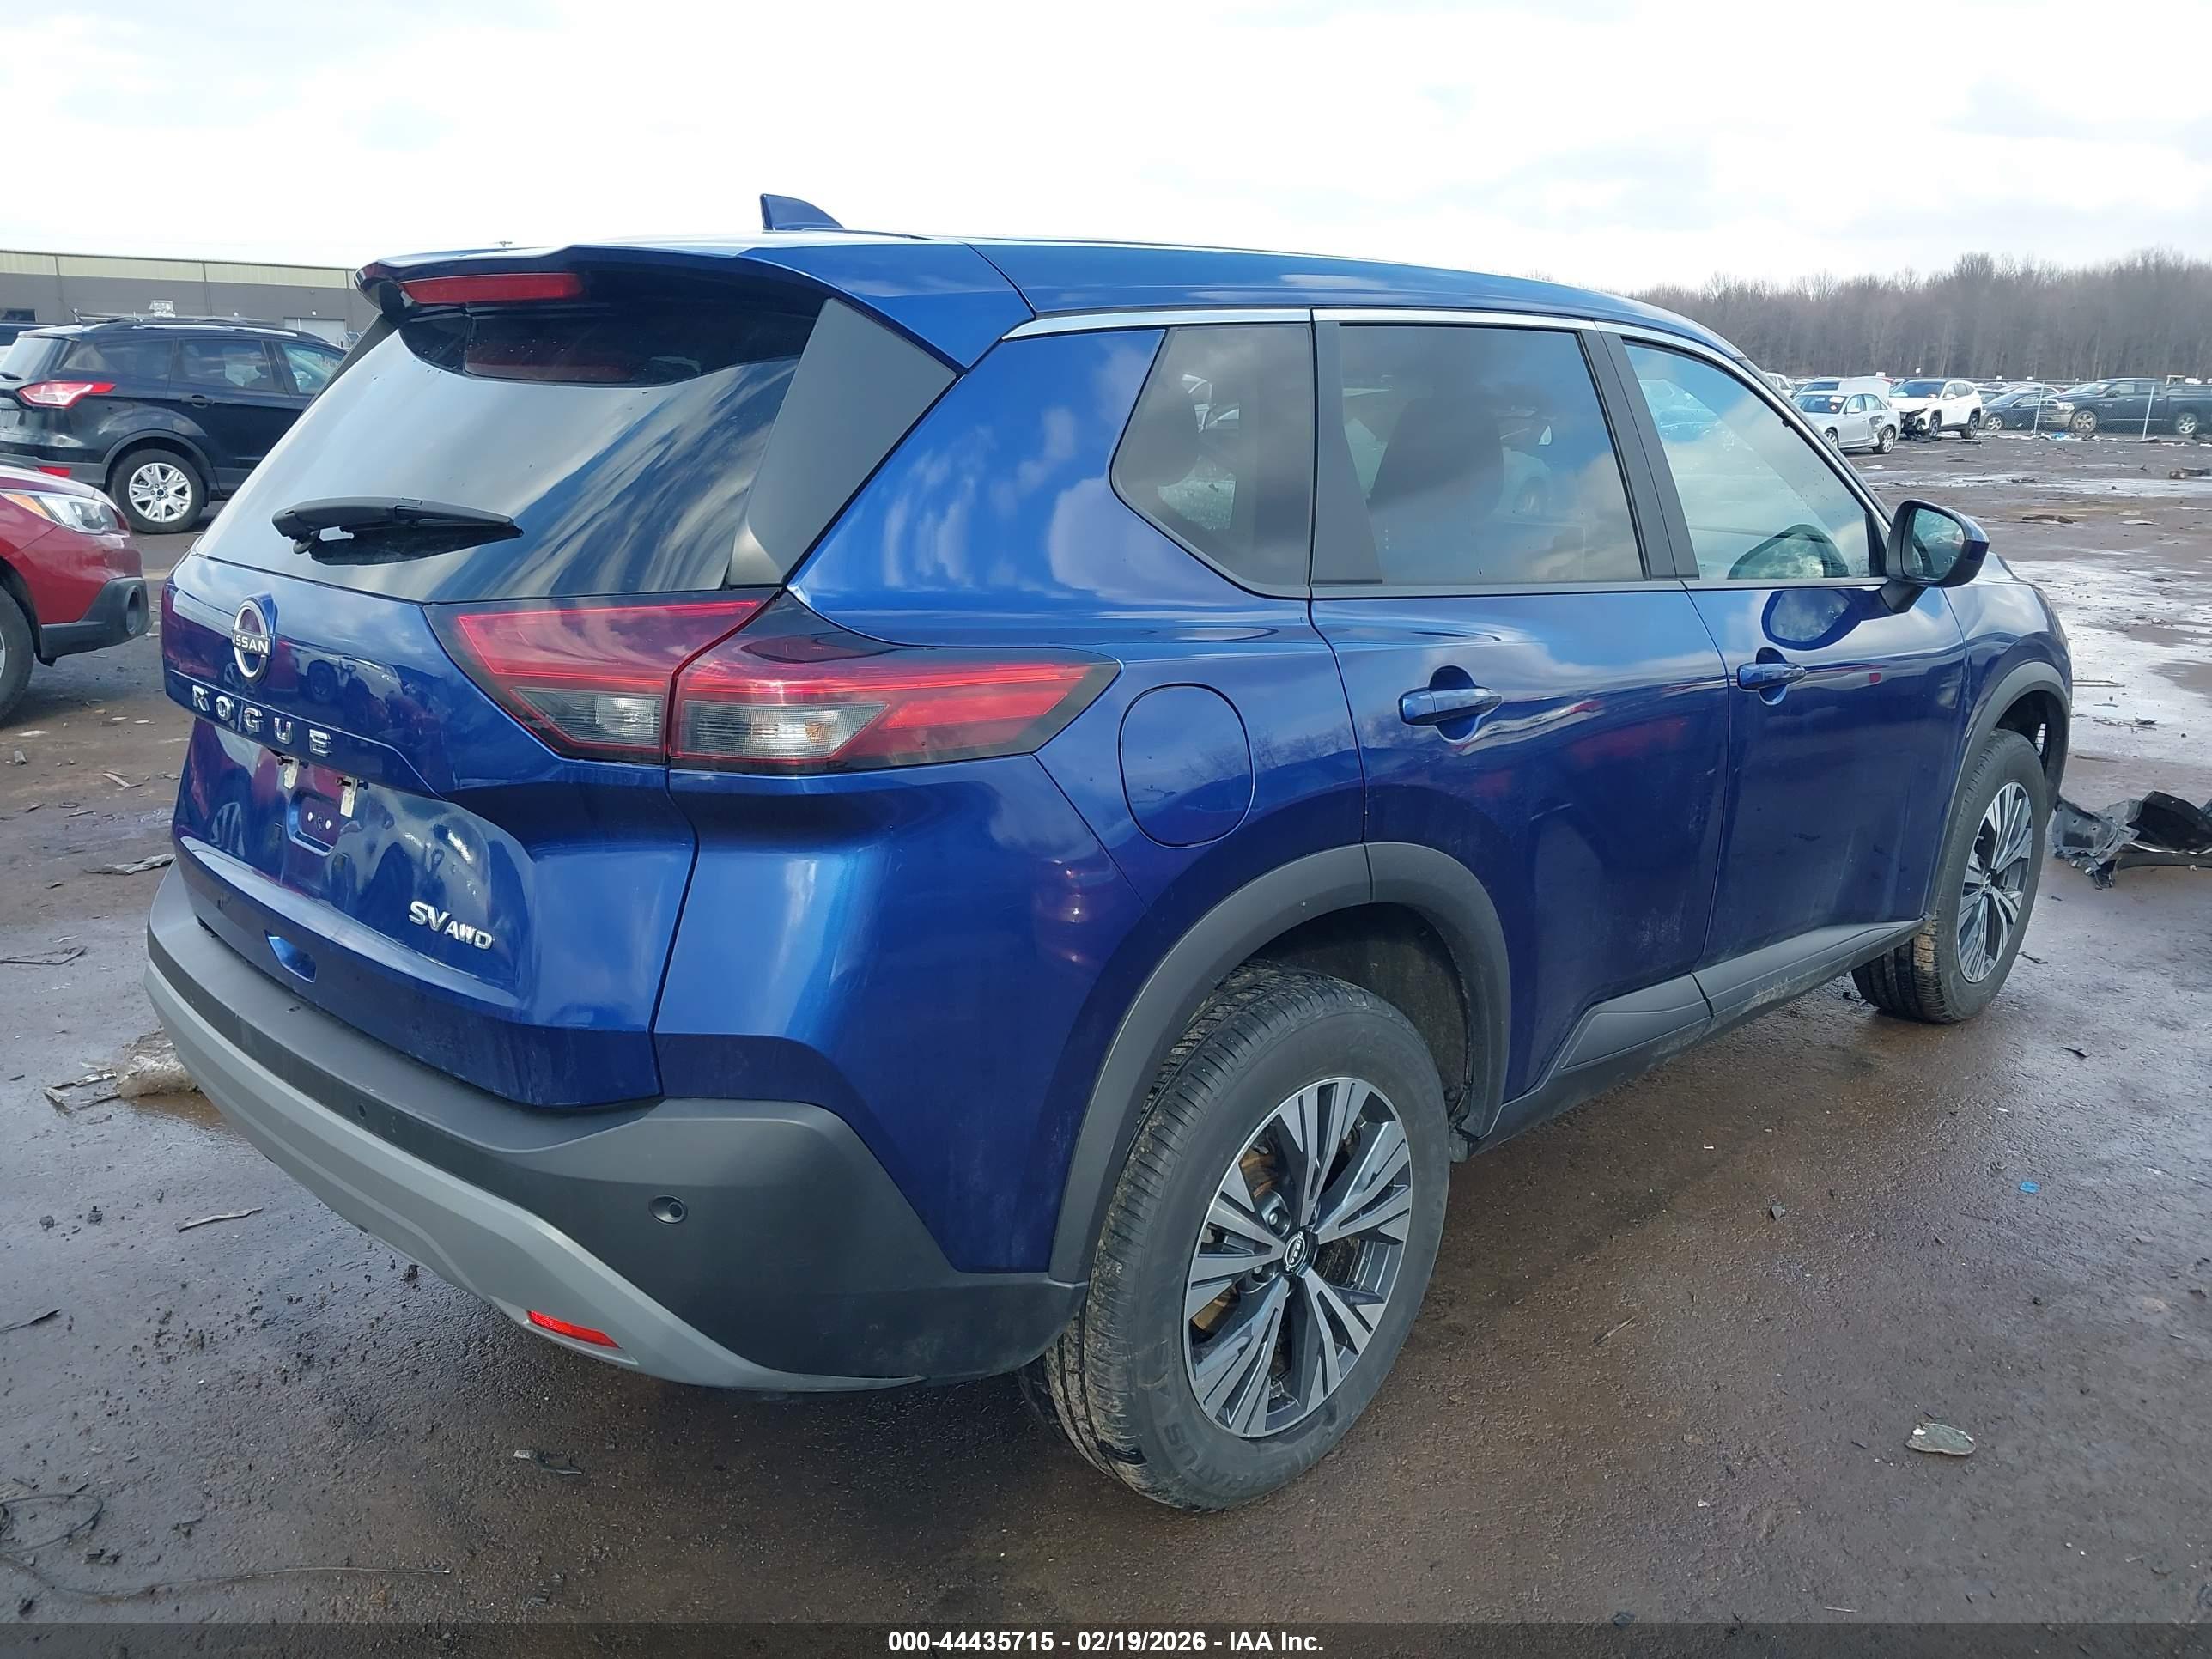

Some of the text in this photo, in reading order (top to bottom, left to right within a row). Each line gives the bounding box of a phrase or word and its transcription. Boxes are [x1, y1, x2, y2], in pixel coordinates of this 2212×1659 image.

[191, 684, 332, 757] ROGUE
[408, 900, 494, 950] SV AWD
